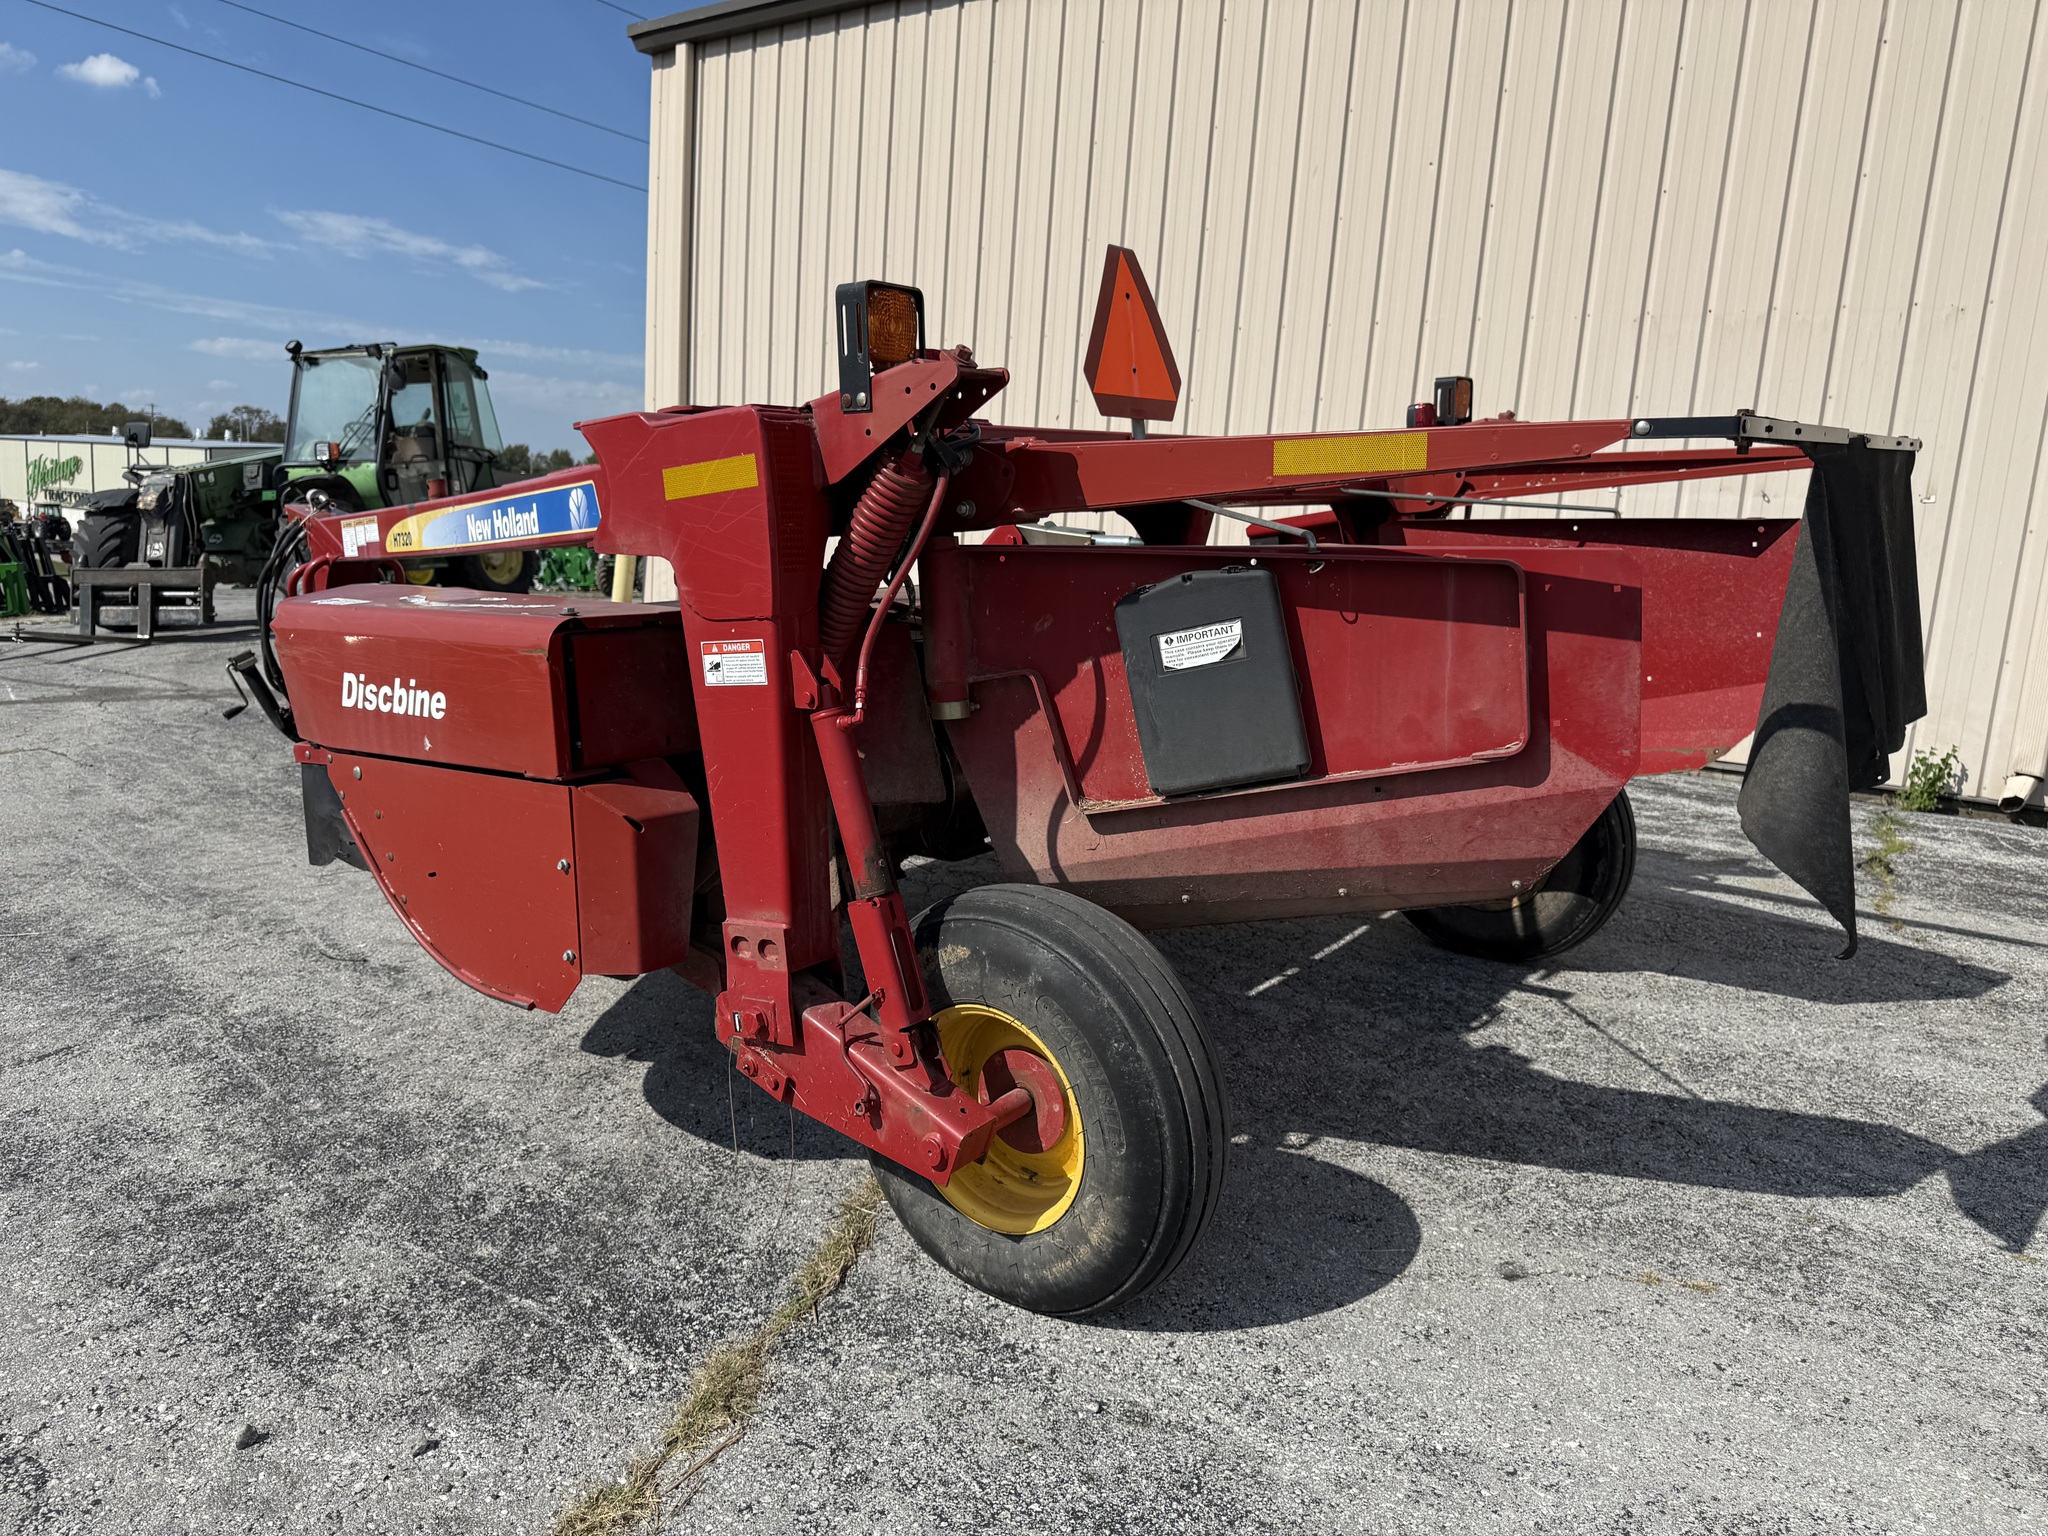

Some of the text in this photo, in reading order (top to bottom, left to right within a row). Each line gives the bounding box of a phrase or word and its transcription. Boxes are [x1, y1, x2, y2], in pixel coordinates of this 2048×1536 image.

[466, 502, 540, 542] New Holland
[393, 531, 413, 547] H7320
[1176, 625, 1234, 644] IMPORTANT
[723, 643, 751, 652] DANGER
[341, 671, 447, 720] Discbine
